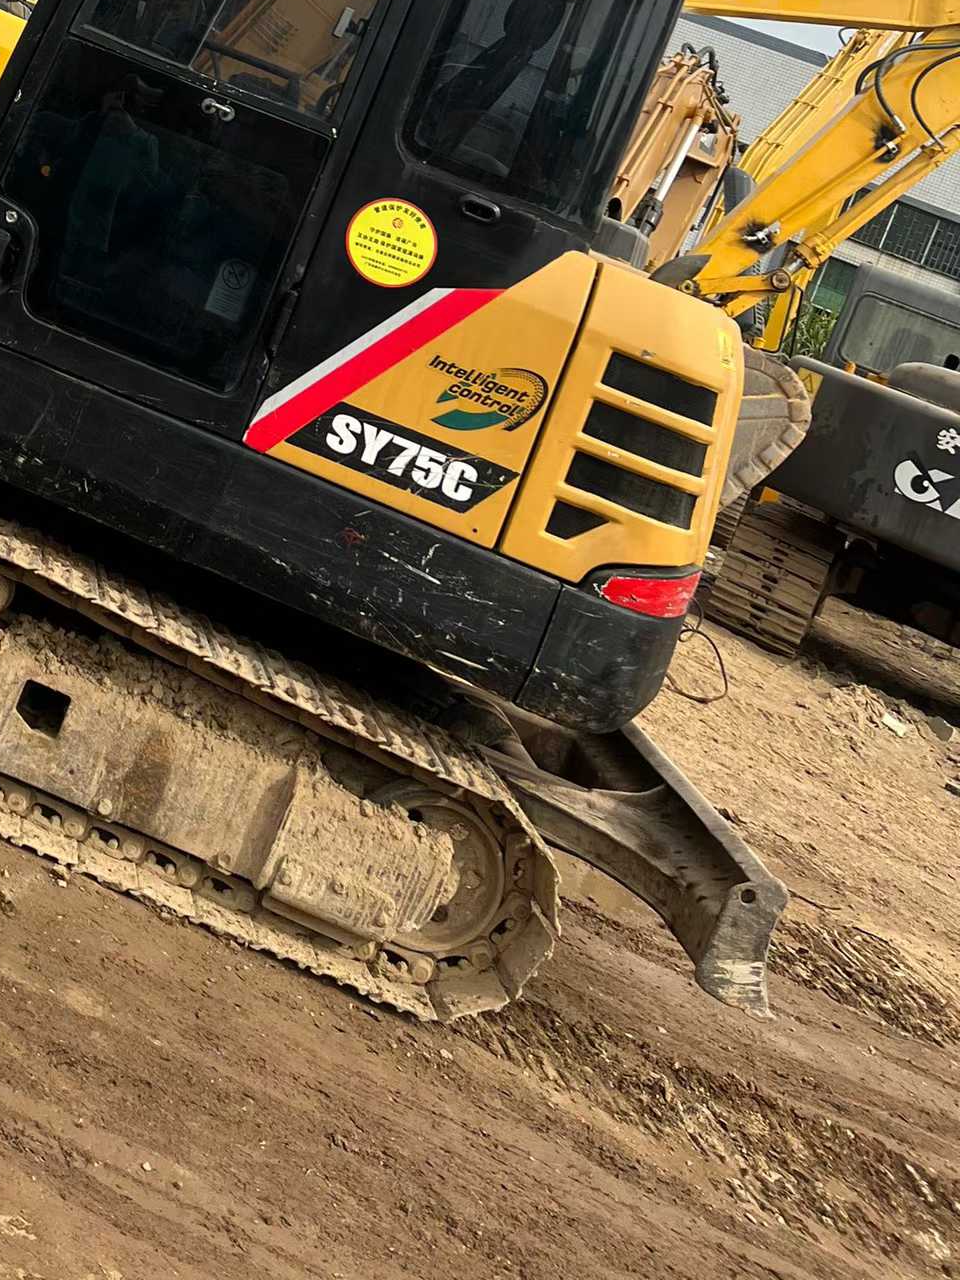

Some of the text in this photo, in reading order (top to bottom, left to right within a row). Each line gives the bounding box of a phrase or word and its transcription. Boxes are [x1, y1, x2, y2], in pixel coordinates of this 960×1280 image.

[427, 355, 530, 402] Intelligent
[448, 384, 520, 417] control
[325, 414, 478, 502] SY75C
